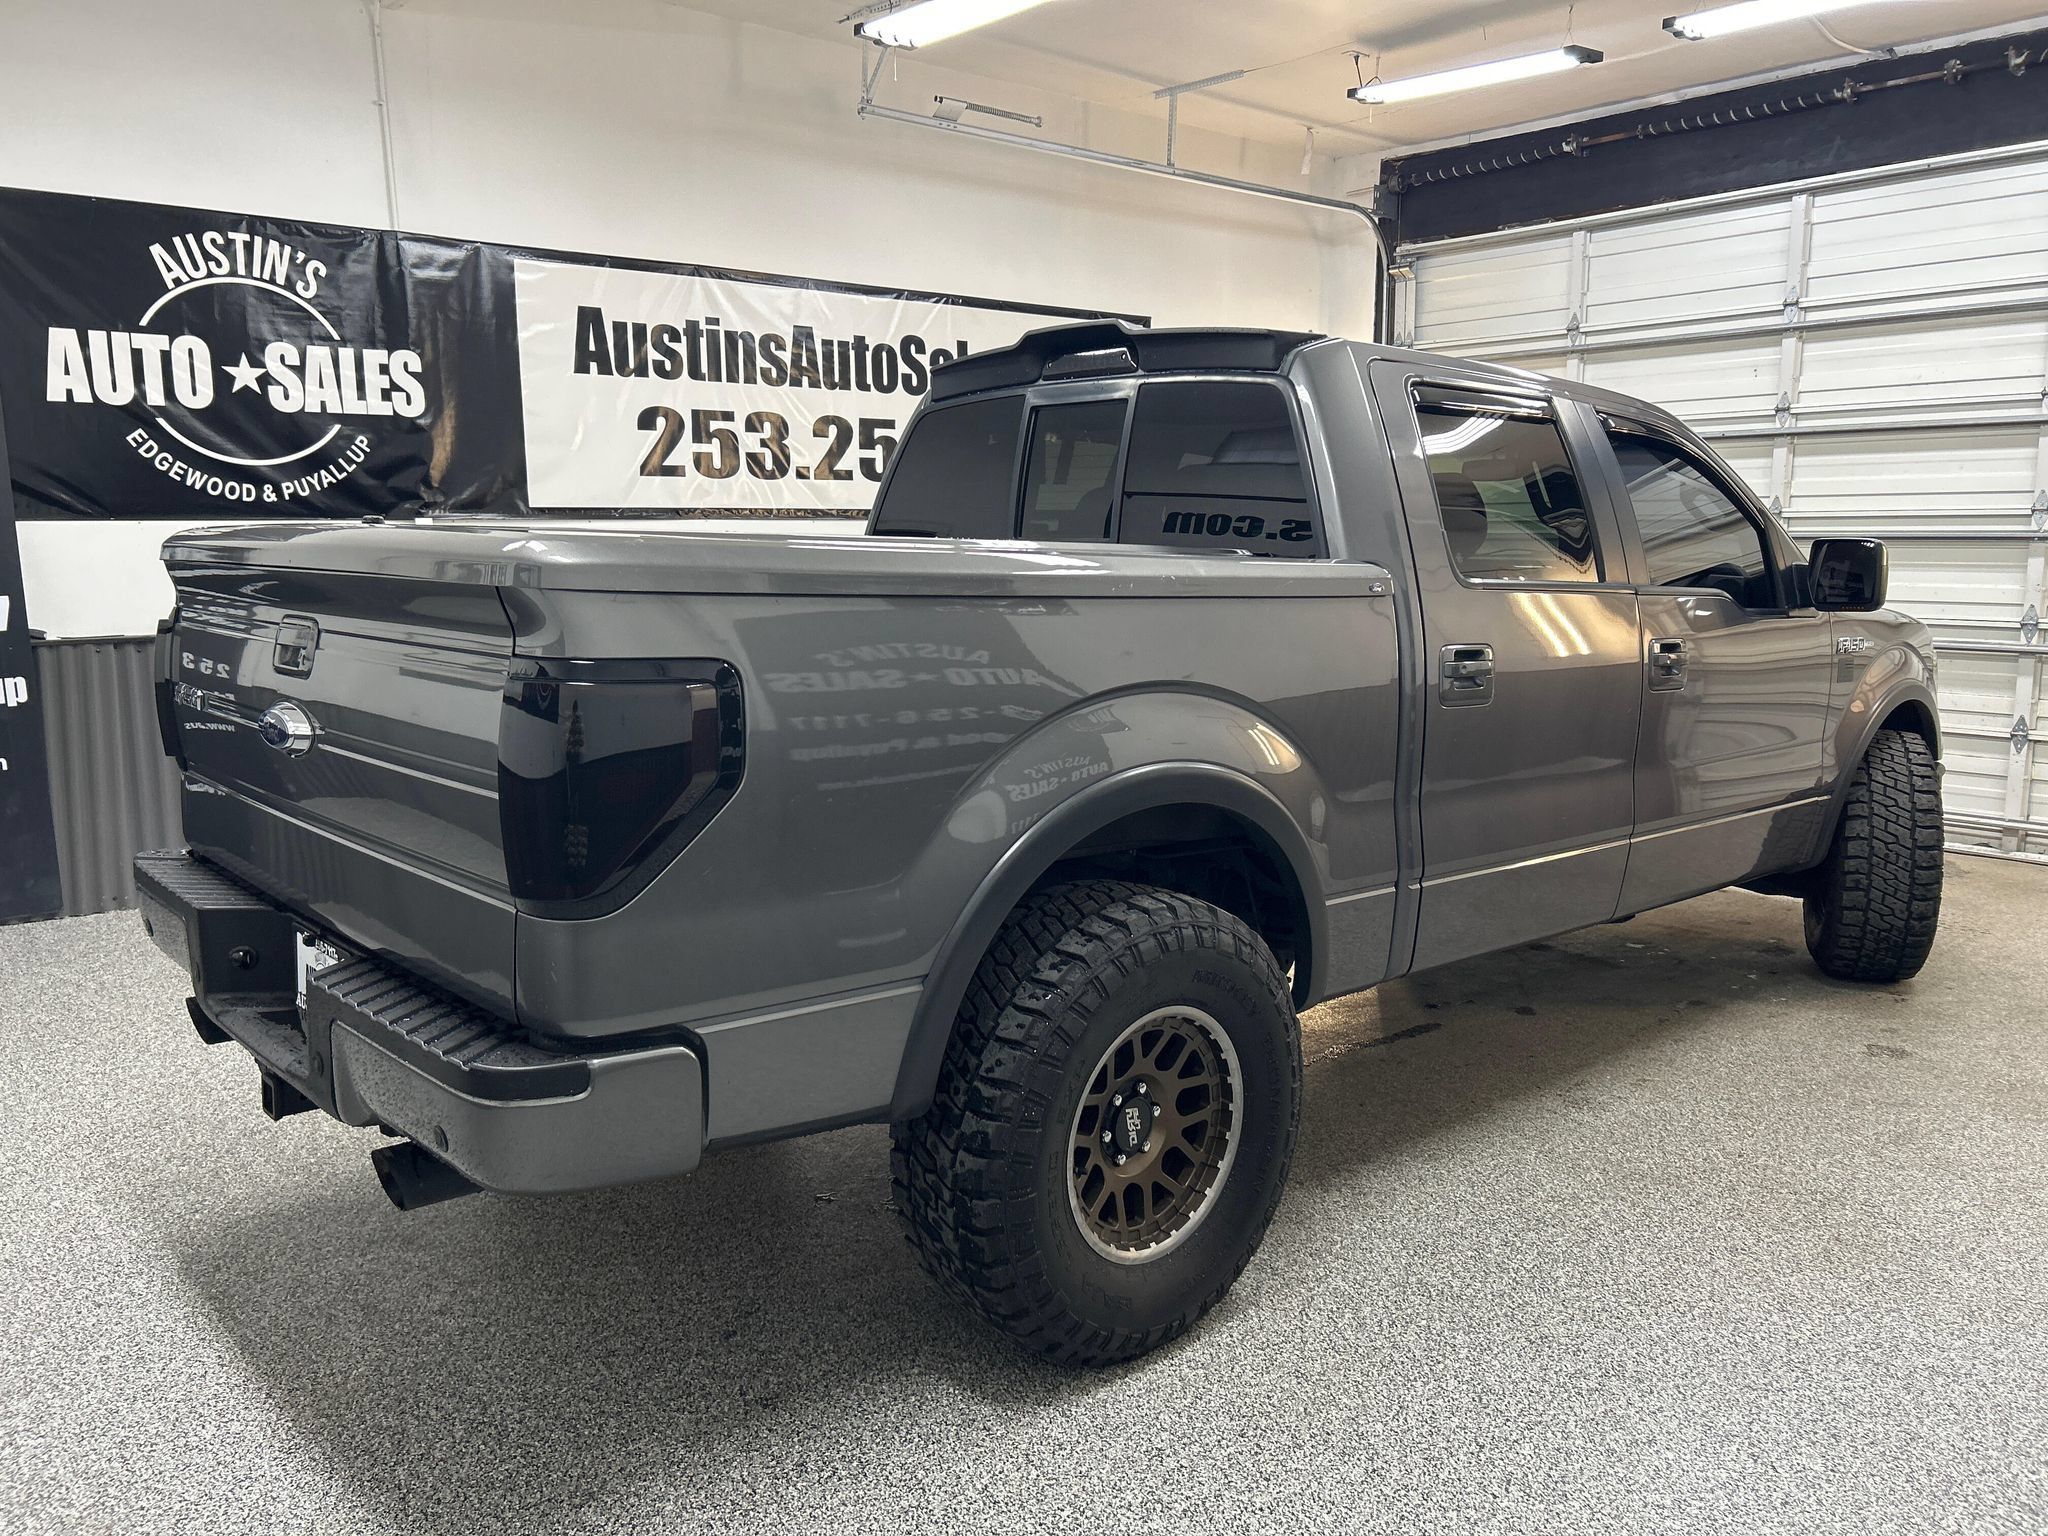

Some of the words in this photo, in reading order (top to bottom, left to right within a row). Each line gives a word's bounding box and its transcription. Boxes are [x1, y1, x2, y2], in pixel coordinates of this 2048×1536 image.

[149, 230, 327, 299] AUSTIN'S
[46, 326, 214, 409] AUTO
[264, 341, 426, 418] SALES
[574, 305, 968, 396] AustinsAutoS
[126, 427, 257, 503] EDGEWOOD
[262, 484, 278, 503] &
[282, 435, 371, 500] PUYALLUP
[637, 405, 897, 482] 253.25
